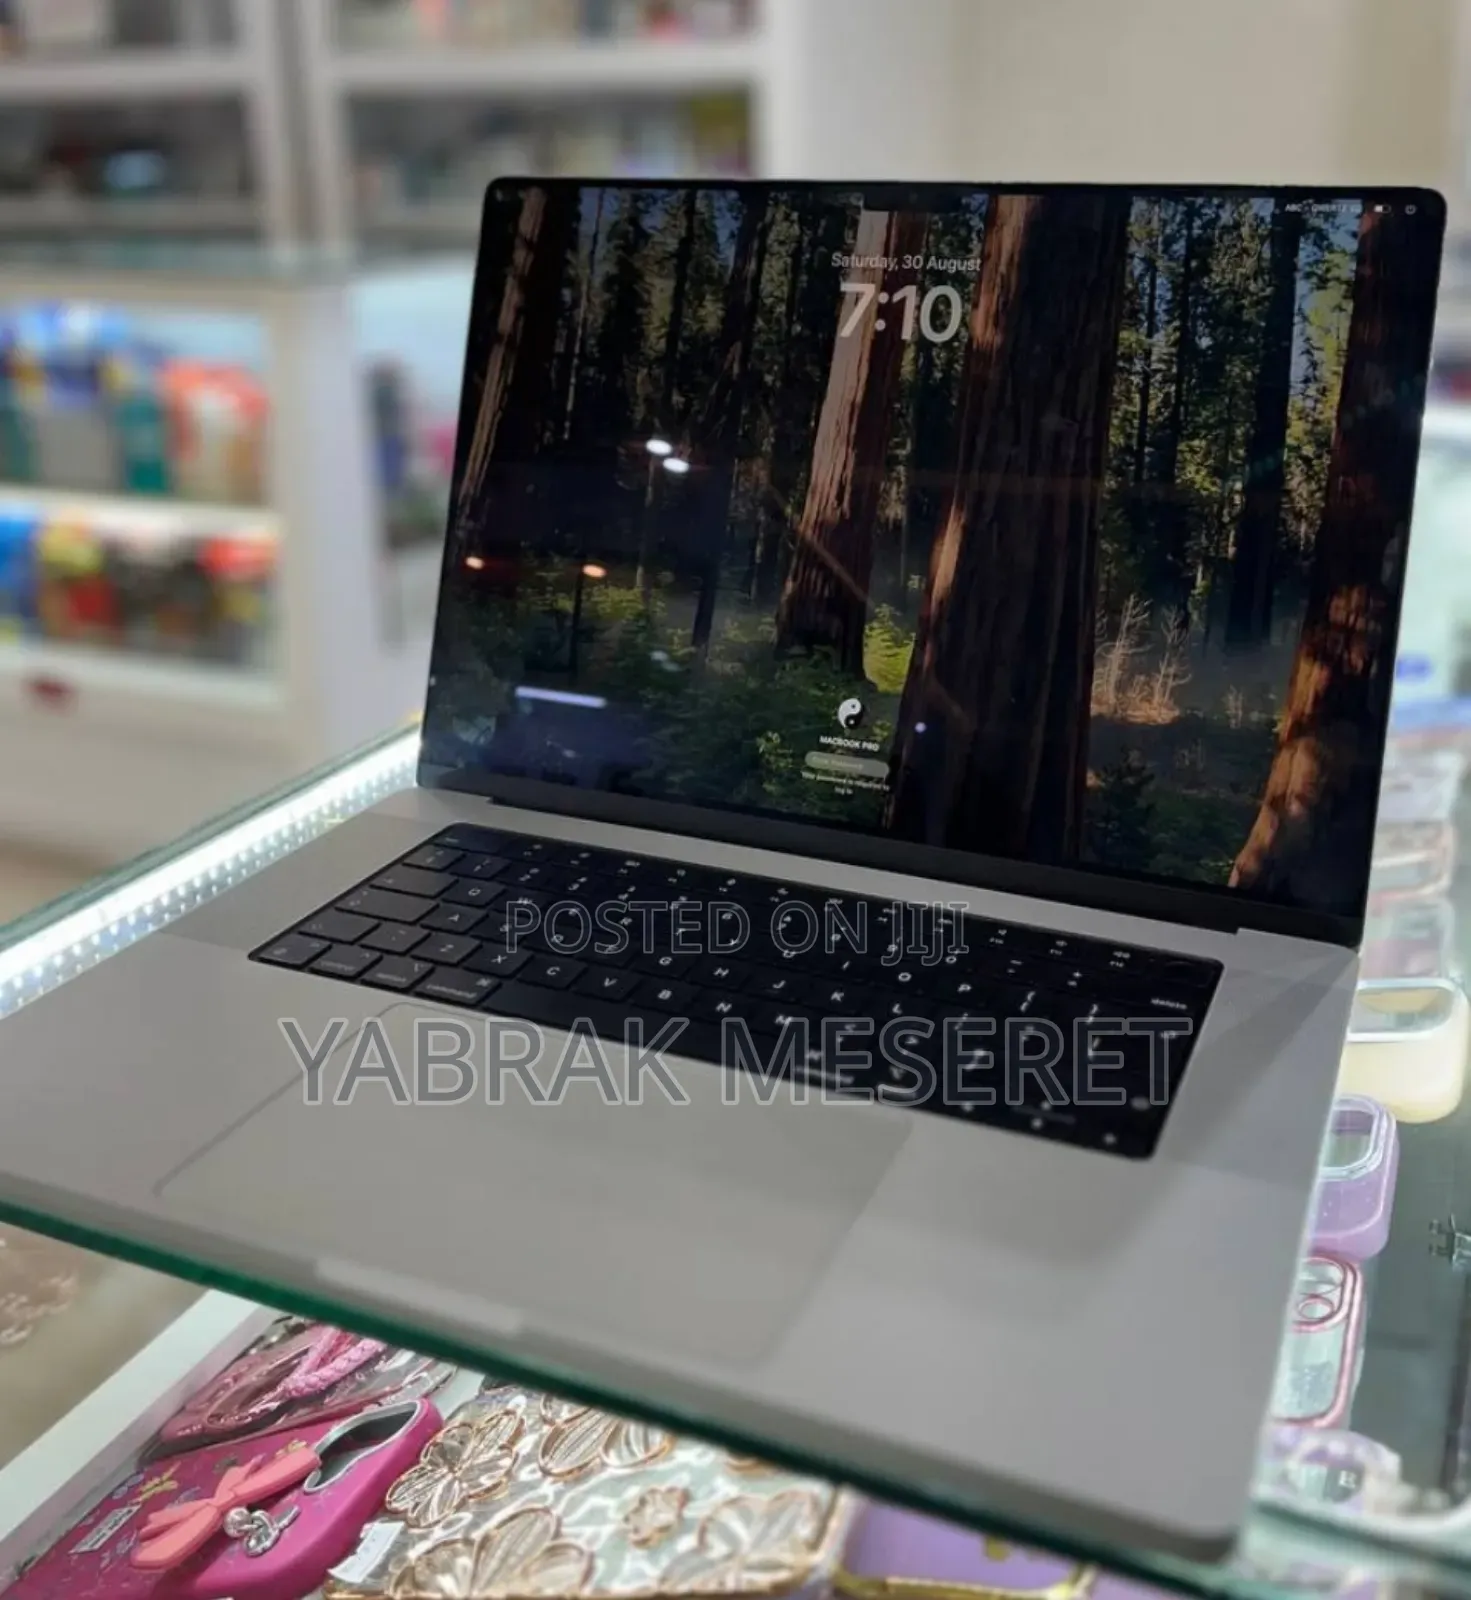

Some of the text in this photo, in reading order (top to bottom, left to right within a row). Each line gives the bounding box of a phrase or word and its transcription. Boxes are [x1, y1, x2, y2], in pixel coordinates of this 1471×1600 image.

[831, 252, 981, 273] Saturday, 30 August
[839, 283, 962, 342] 7:10
